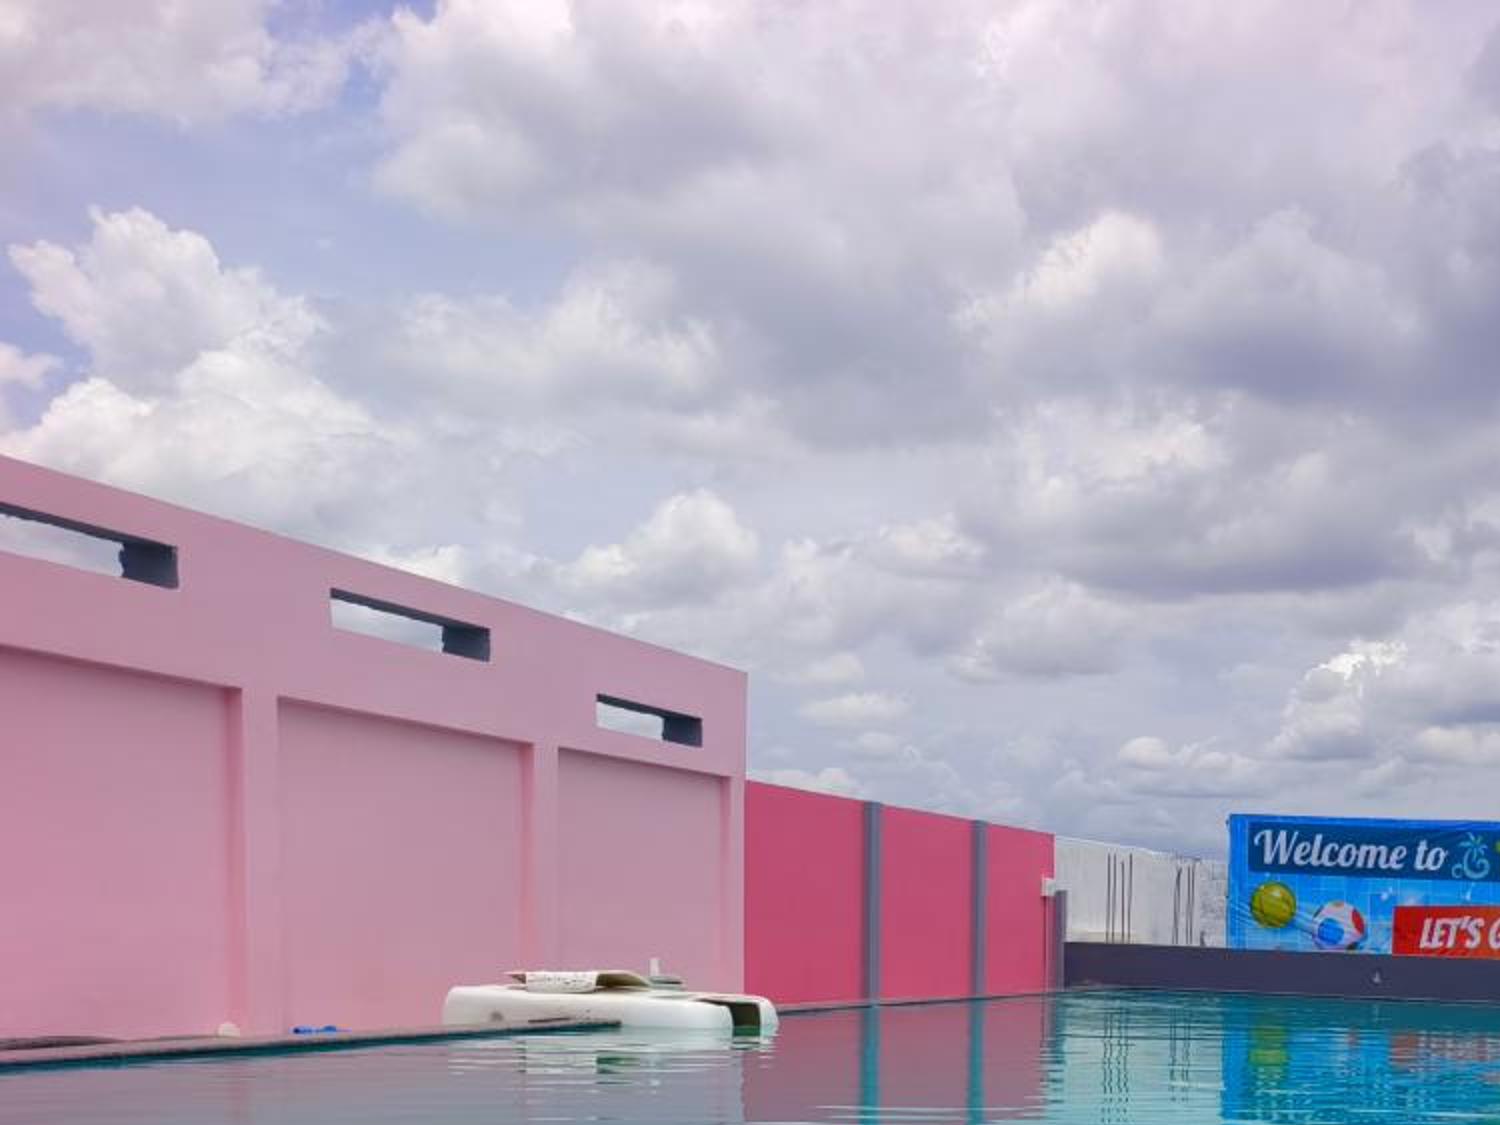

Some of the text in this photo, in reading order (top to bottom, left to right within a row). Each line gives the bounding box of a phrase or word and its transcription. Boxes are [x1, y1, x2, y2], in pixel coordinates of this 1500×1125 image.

[1254, 829, 1407, 870] Welcome
[1414, 840, 1449, 871] to
[1419, 916, 1485, 949] LET'S
